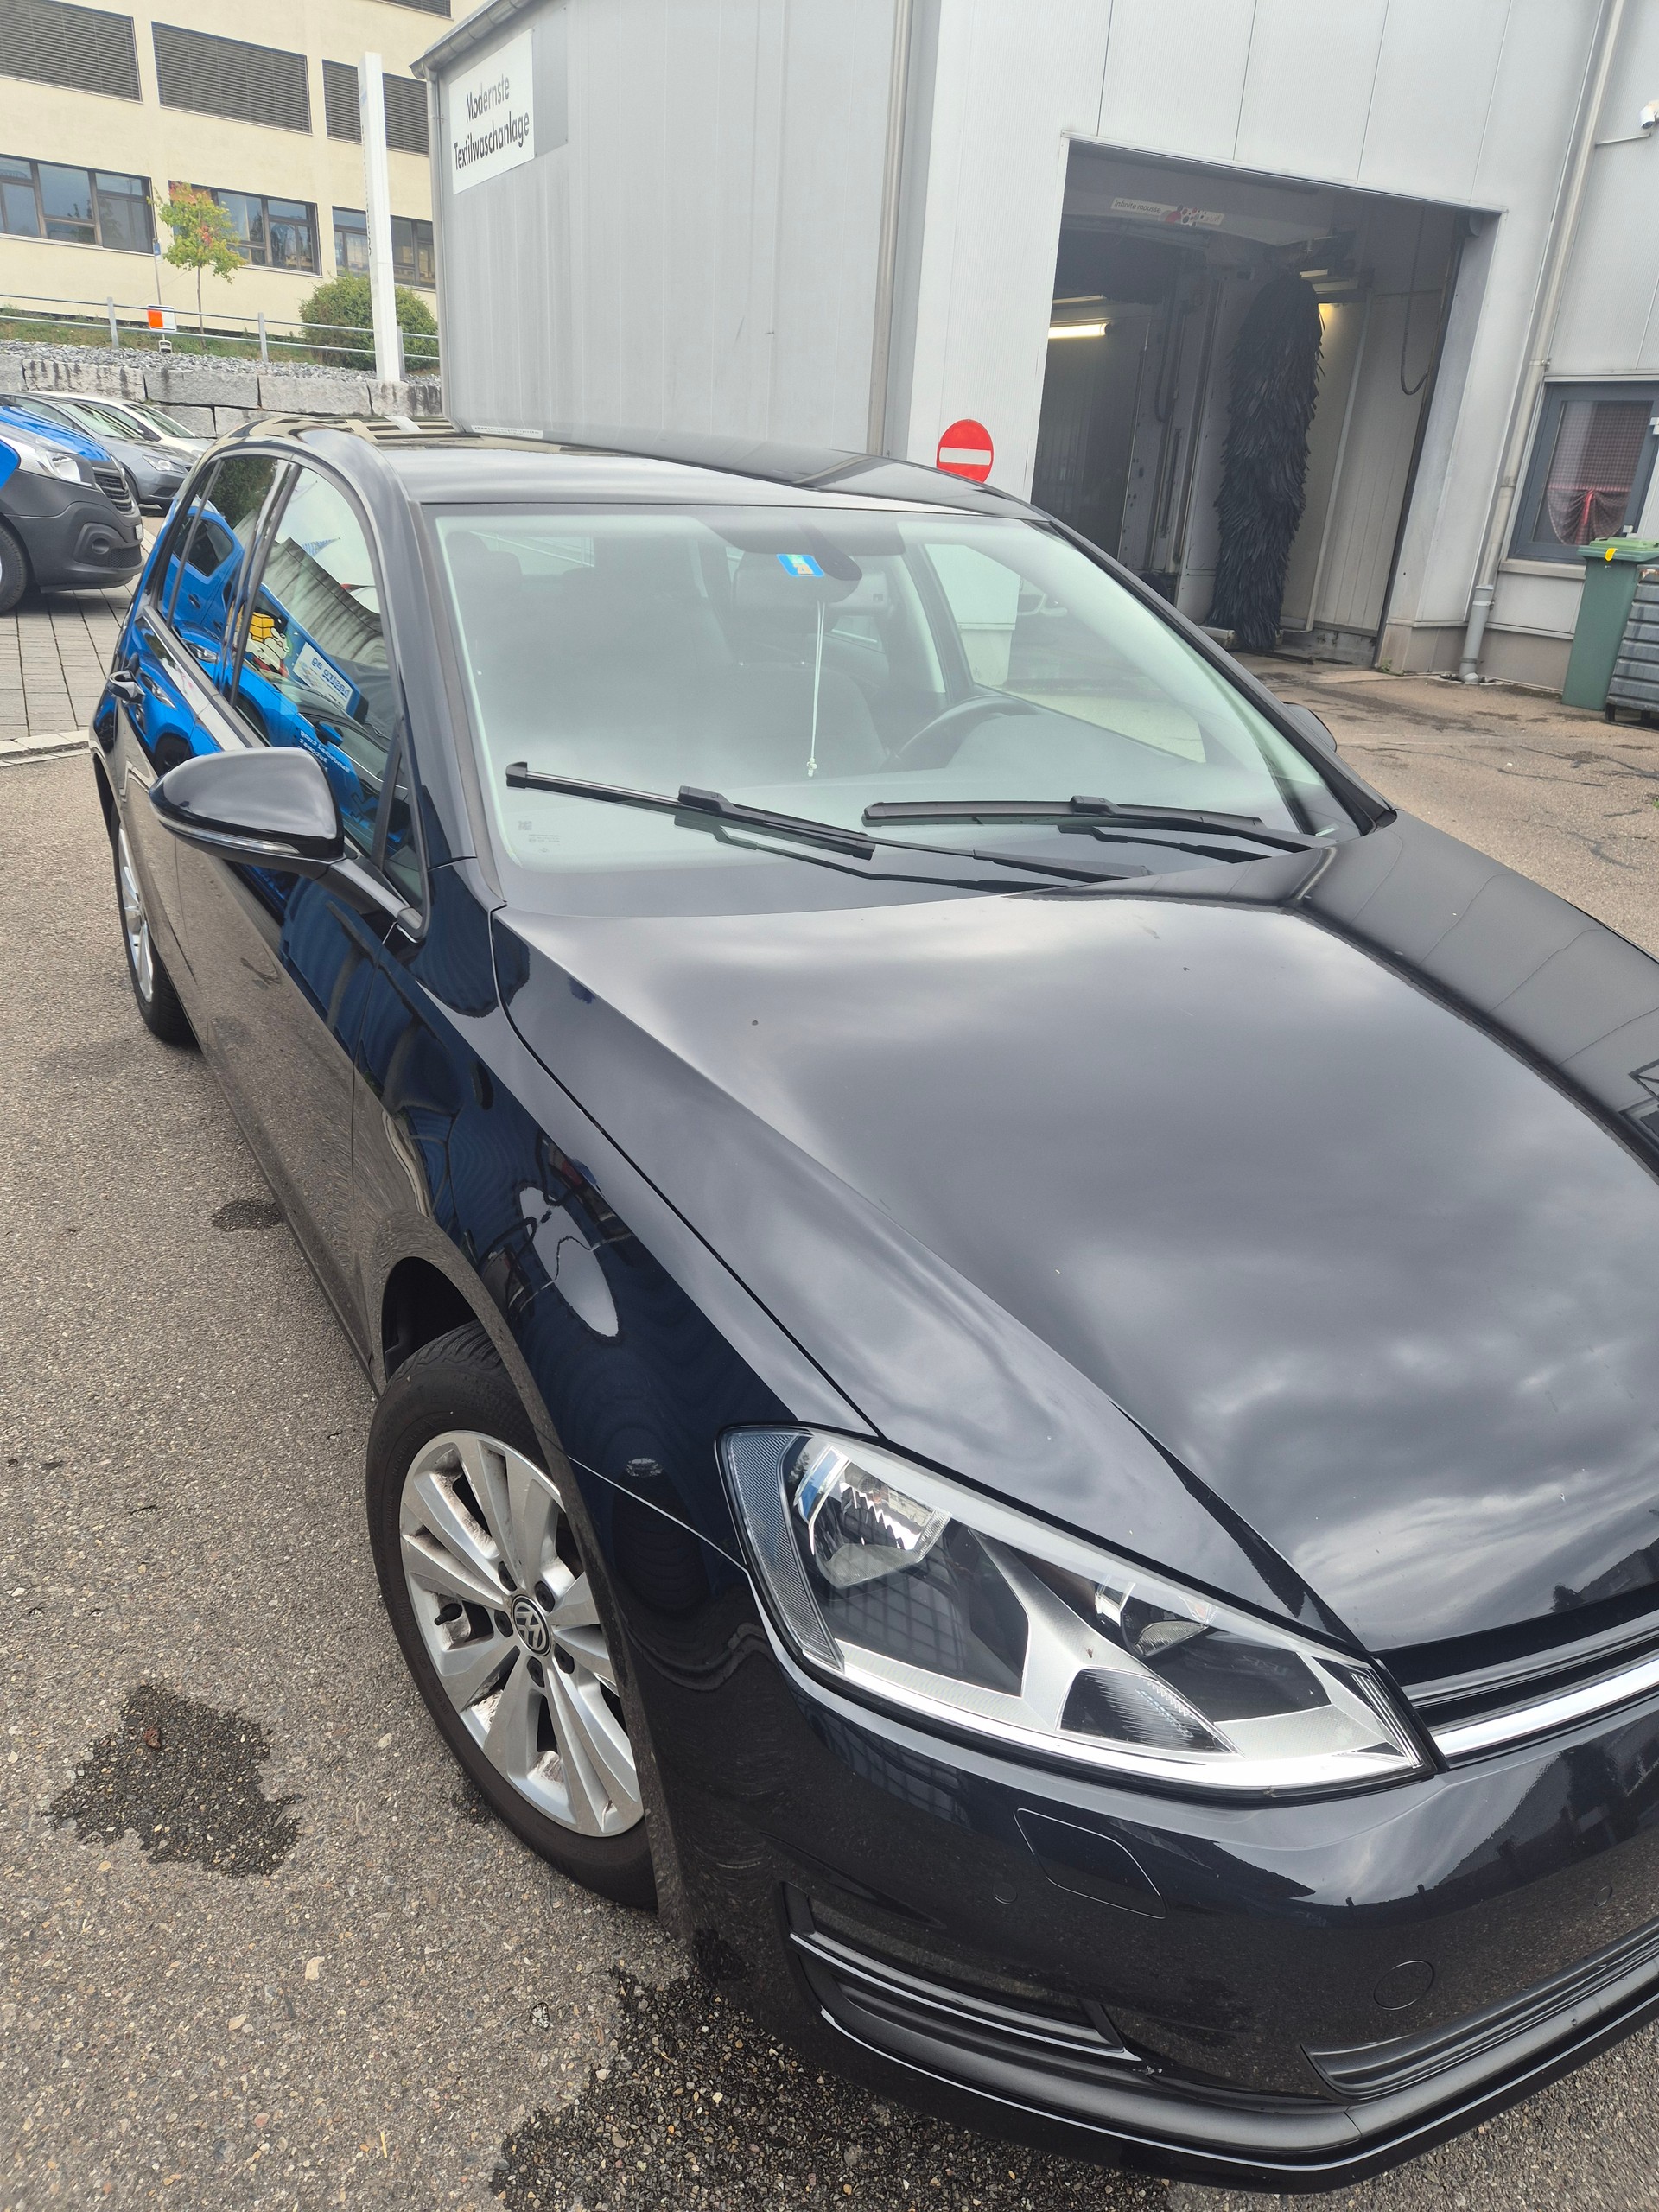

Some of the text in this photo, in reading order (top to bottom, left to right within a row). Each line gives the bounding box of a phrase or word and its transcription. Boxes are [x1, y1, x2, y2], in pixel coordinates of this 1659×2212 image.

[466, 73, 510, 124] Modernste
[454, 111, 530, 170] Textilwaschanlage
[1137, 204, 1161, 213] mousse
